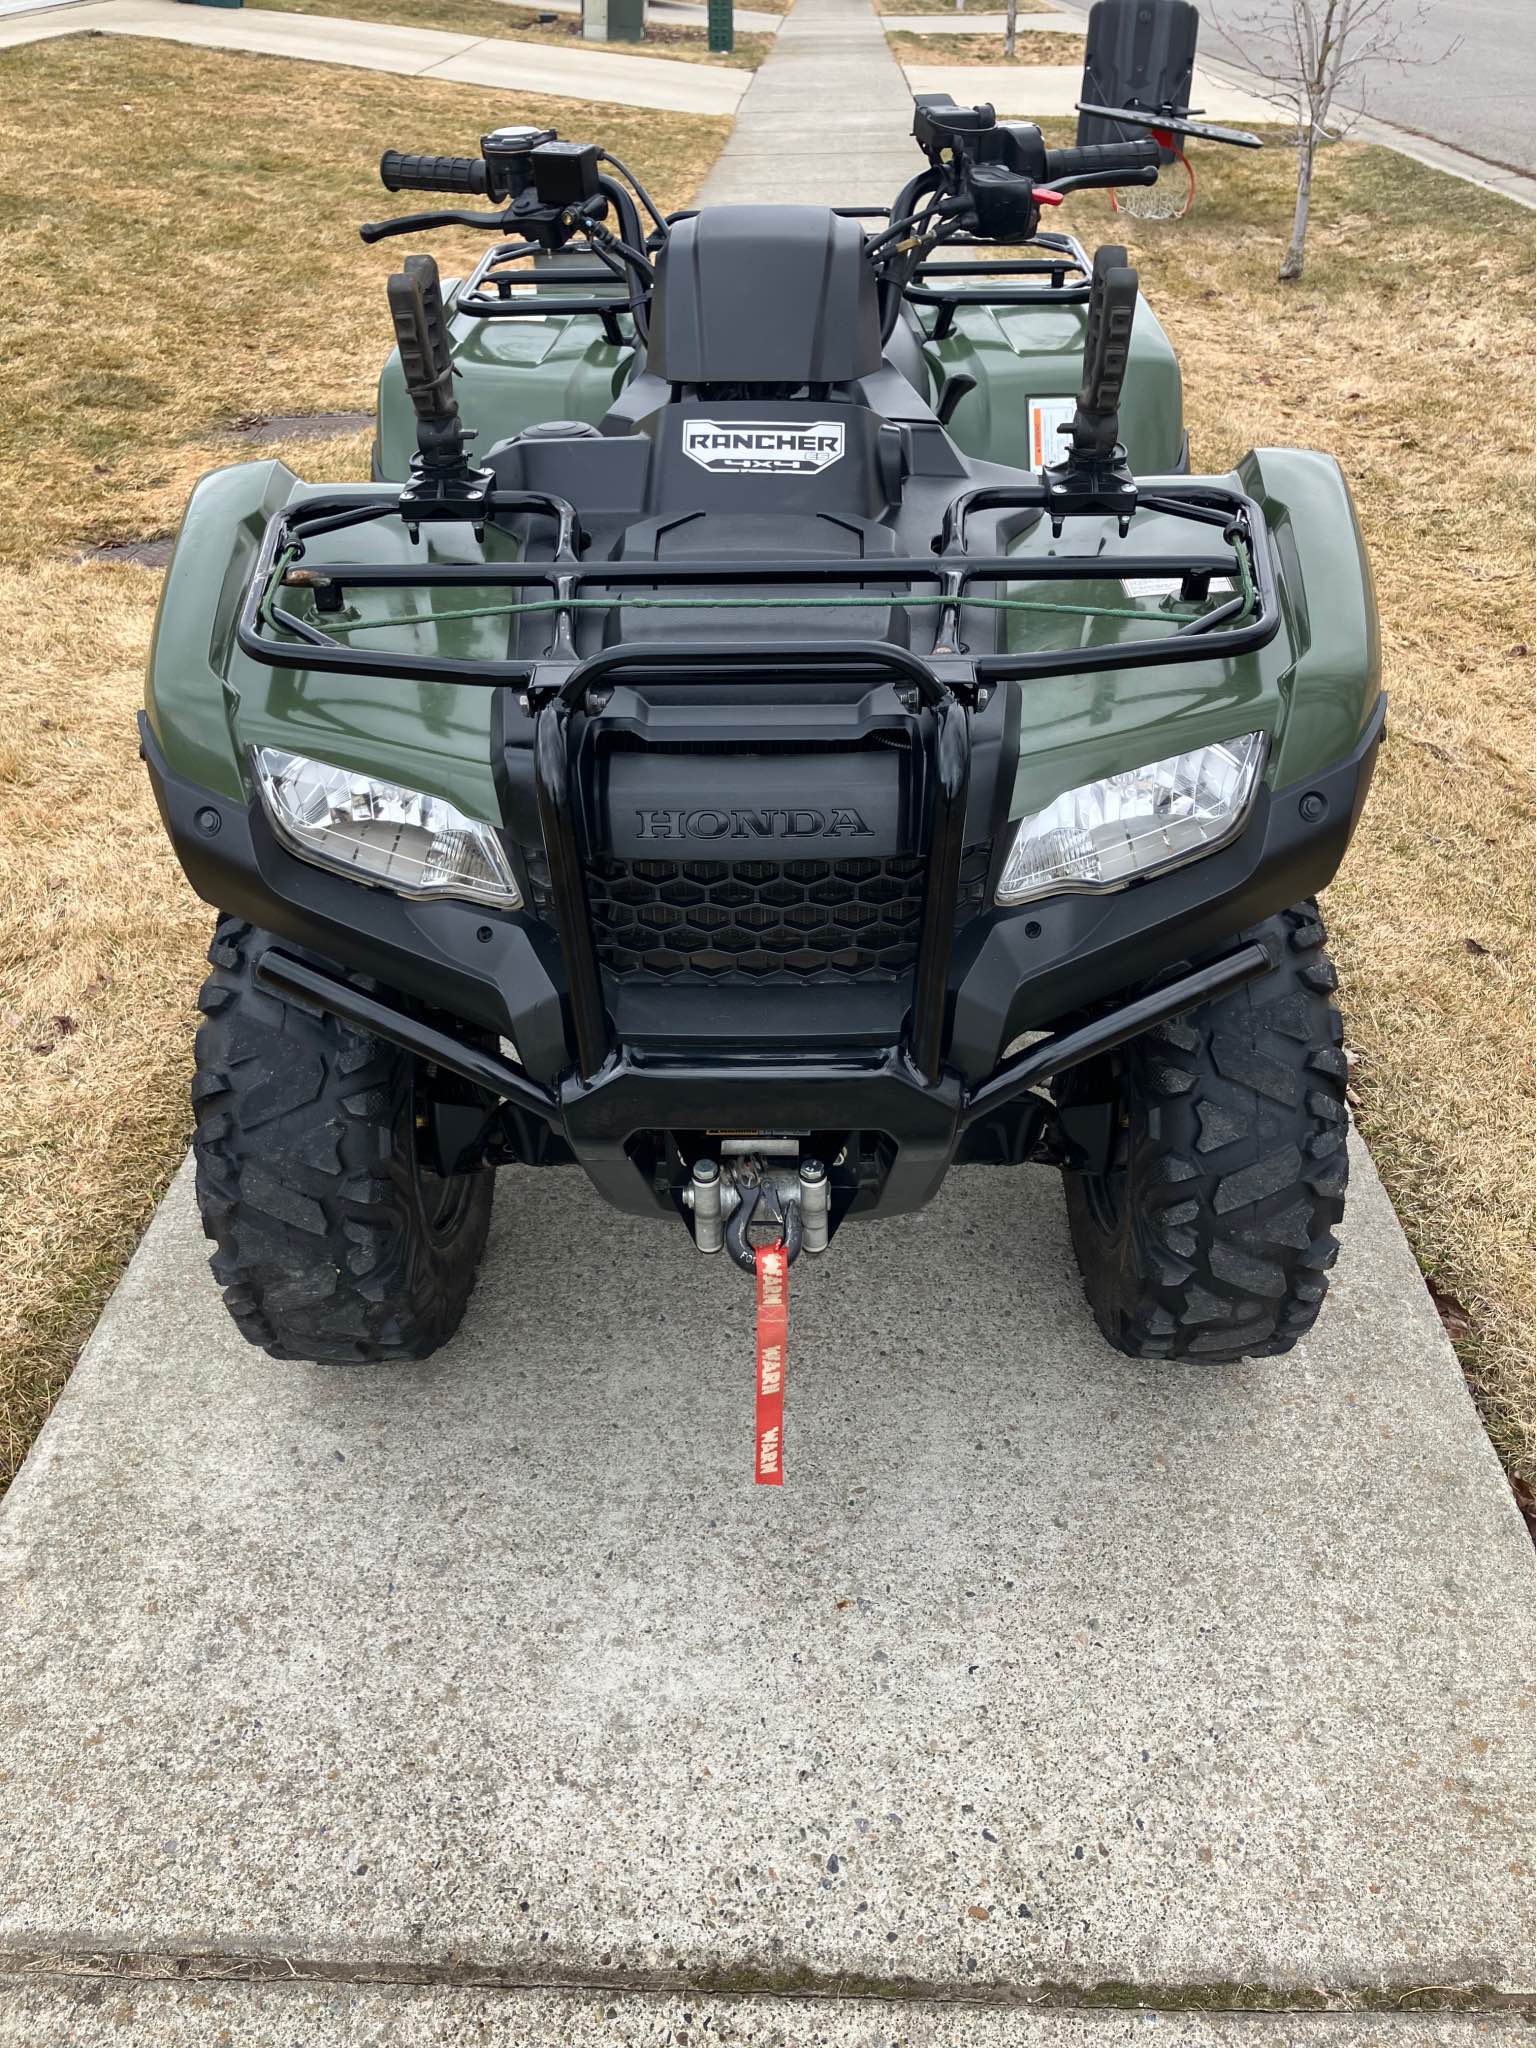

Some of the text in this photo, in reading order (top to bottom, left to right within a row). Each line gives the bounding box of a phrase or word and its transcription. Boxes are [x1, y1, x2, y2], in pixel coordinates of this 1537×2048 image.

[689, 434, 839, 452] RANCHER
[635, 808, 876, 840] HONDA
[761, 1253, 783, 1305] WARN
[761, 1344, 781, 1395] WARN
[760, 1425, 779, 1474] WARN
